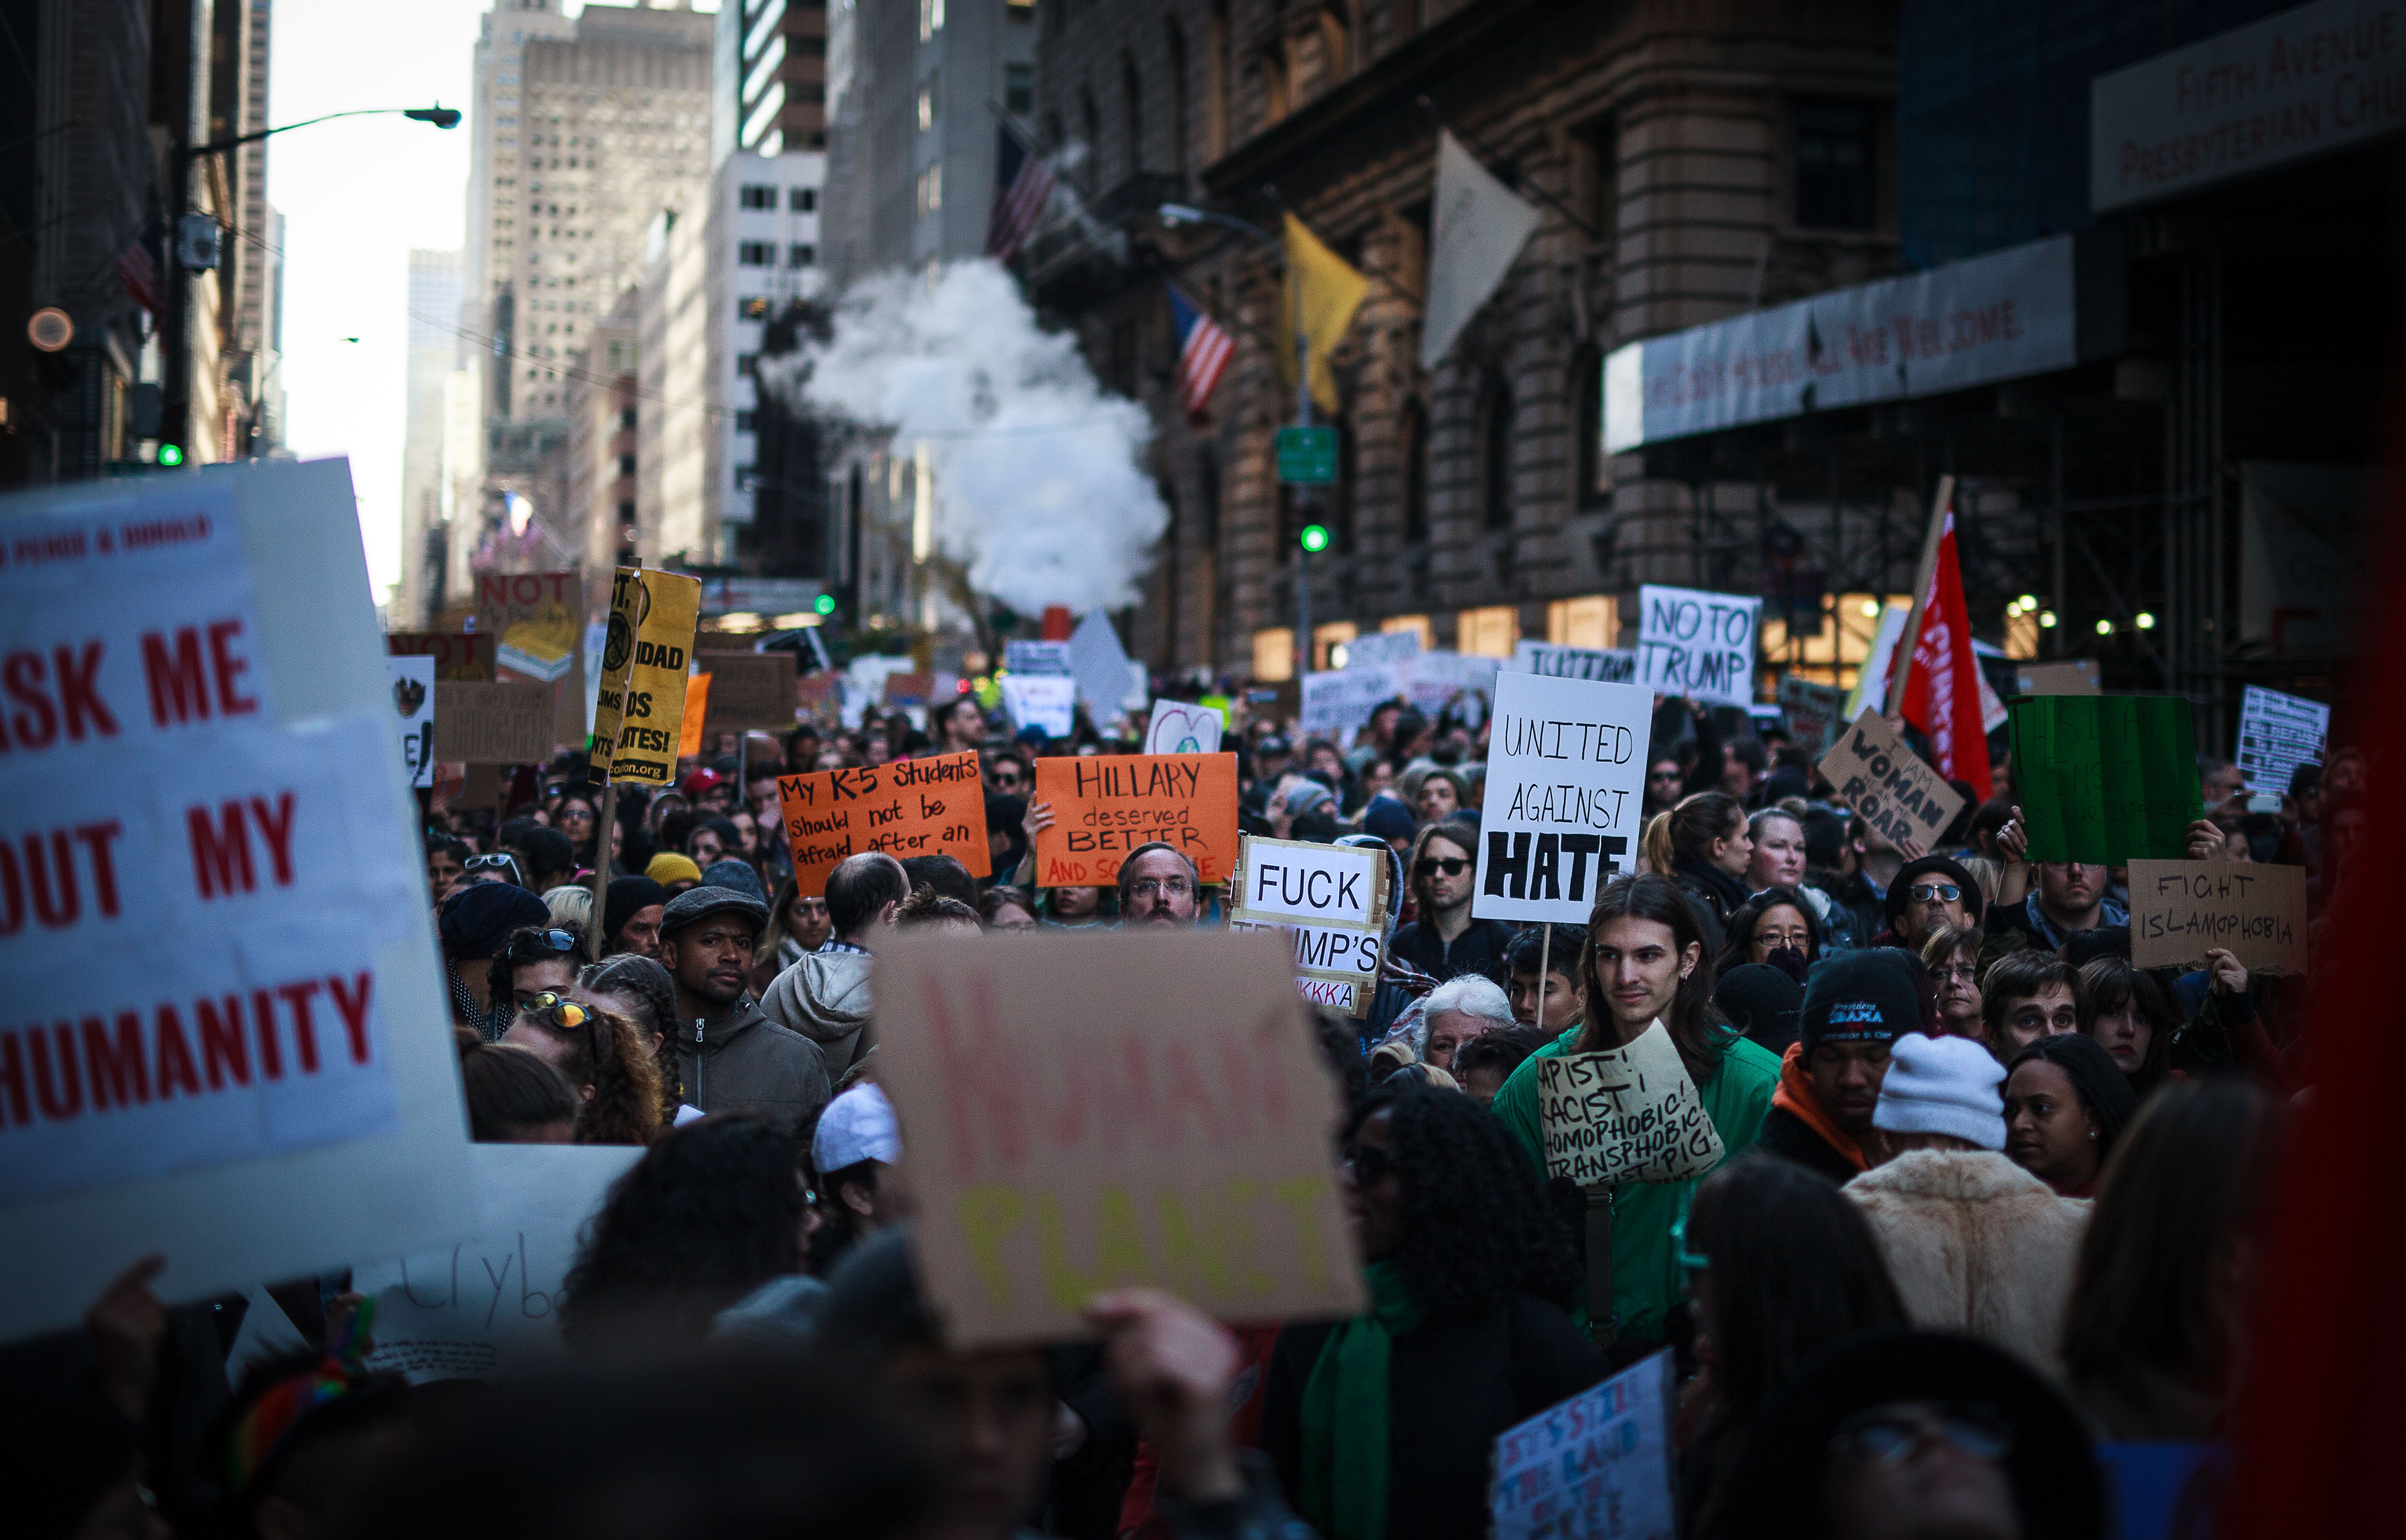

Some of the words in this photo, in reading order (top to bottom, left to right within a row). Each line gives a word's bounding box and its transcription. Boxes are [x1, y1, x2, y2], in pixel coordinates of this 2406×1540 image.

[481, 574, 571, 607] NOT
[612, 573, 630, 609] T.
[1651, 599, 1701, 640] NO
[1707, 605, 1749, 646] TO
[0, 638, 122, 754] SK
[139, 619, 259, 728] ME
[1638, 641, 1746, 696] TRUMP
[597, 689, 621, 710] IMS
[1505, 714, 1633, 764] UNITED
[779, 777, 814, 806] My
[830, 766, 880, 801] K-5
[894, 756, 978, 787] Students
[1075, 761, 1200, 799] HILLARY
[1851, 729, 1945, 829] WOMAN
[869, 799, 904, 828] not
[921, 794, 946, 819] be
[1083, 806, 1190, 827] deserved
[1507, 782, 1629, 829] AGAINST
[1841, 776, 1912, 847] ROAR
[185, 790, 298, 902] MY
[797, 835, 851, 865] afraid
[867, 832, 931, 852] after
[942, 825, 969, 842] an
[1068, 827, 1209, 852] BETTER
[1049, 858, 1088, 883] AND
[1258, 864, 1361, 910] FUCK
[1483, 831, 1628, 902] HATE
[2158, 874, 2254, 900] FIGHT
[2141, 909, 2293, 945] ISLAMOPHOBIA
[1830, 1011, 1883, 1024] OBAMA
[958, 1174, 1329, 1317] PLANET
